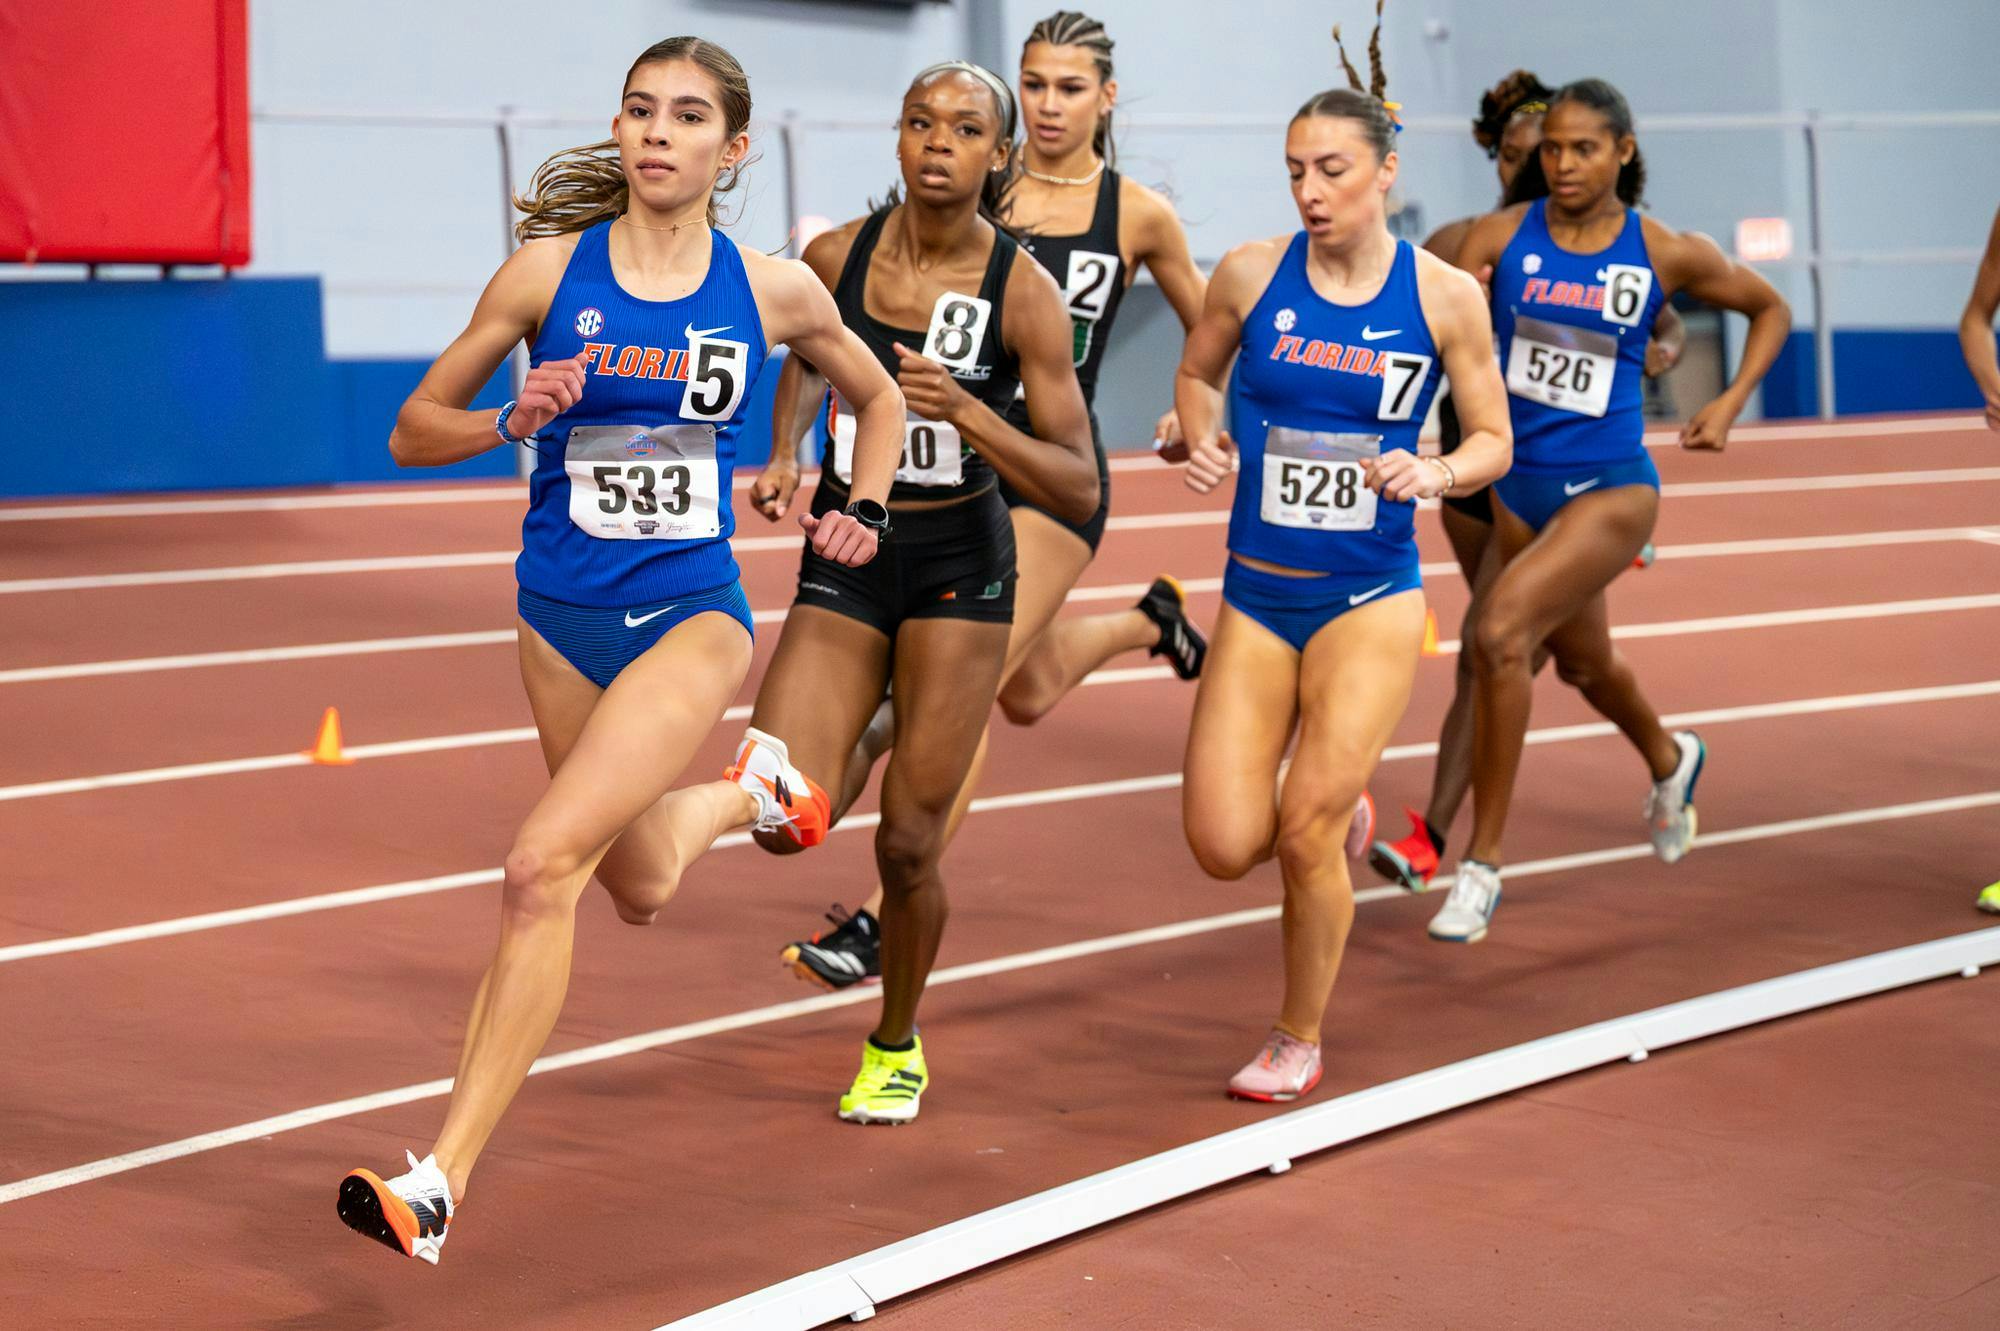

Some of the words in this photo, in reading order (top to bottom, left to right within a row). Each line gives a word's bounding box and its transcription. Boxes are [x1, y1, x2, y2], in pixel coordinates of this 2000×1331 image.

[1069, 259, 1107, 312] 2
[1611, 271, 1641, 318] 6
[576, 309, 602, 336] SEC
[934, 300, 979, 360] 8
[690, 343, 736, 416] 5
[1270, 334, 1386, 378] FLORIDA
[1526, 347, 1595, 393] 526
[1389, 359, 1423, 414] 7
[593, 464, 692, 517] 533
[1279, 463, 1358, 509] 528
